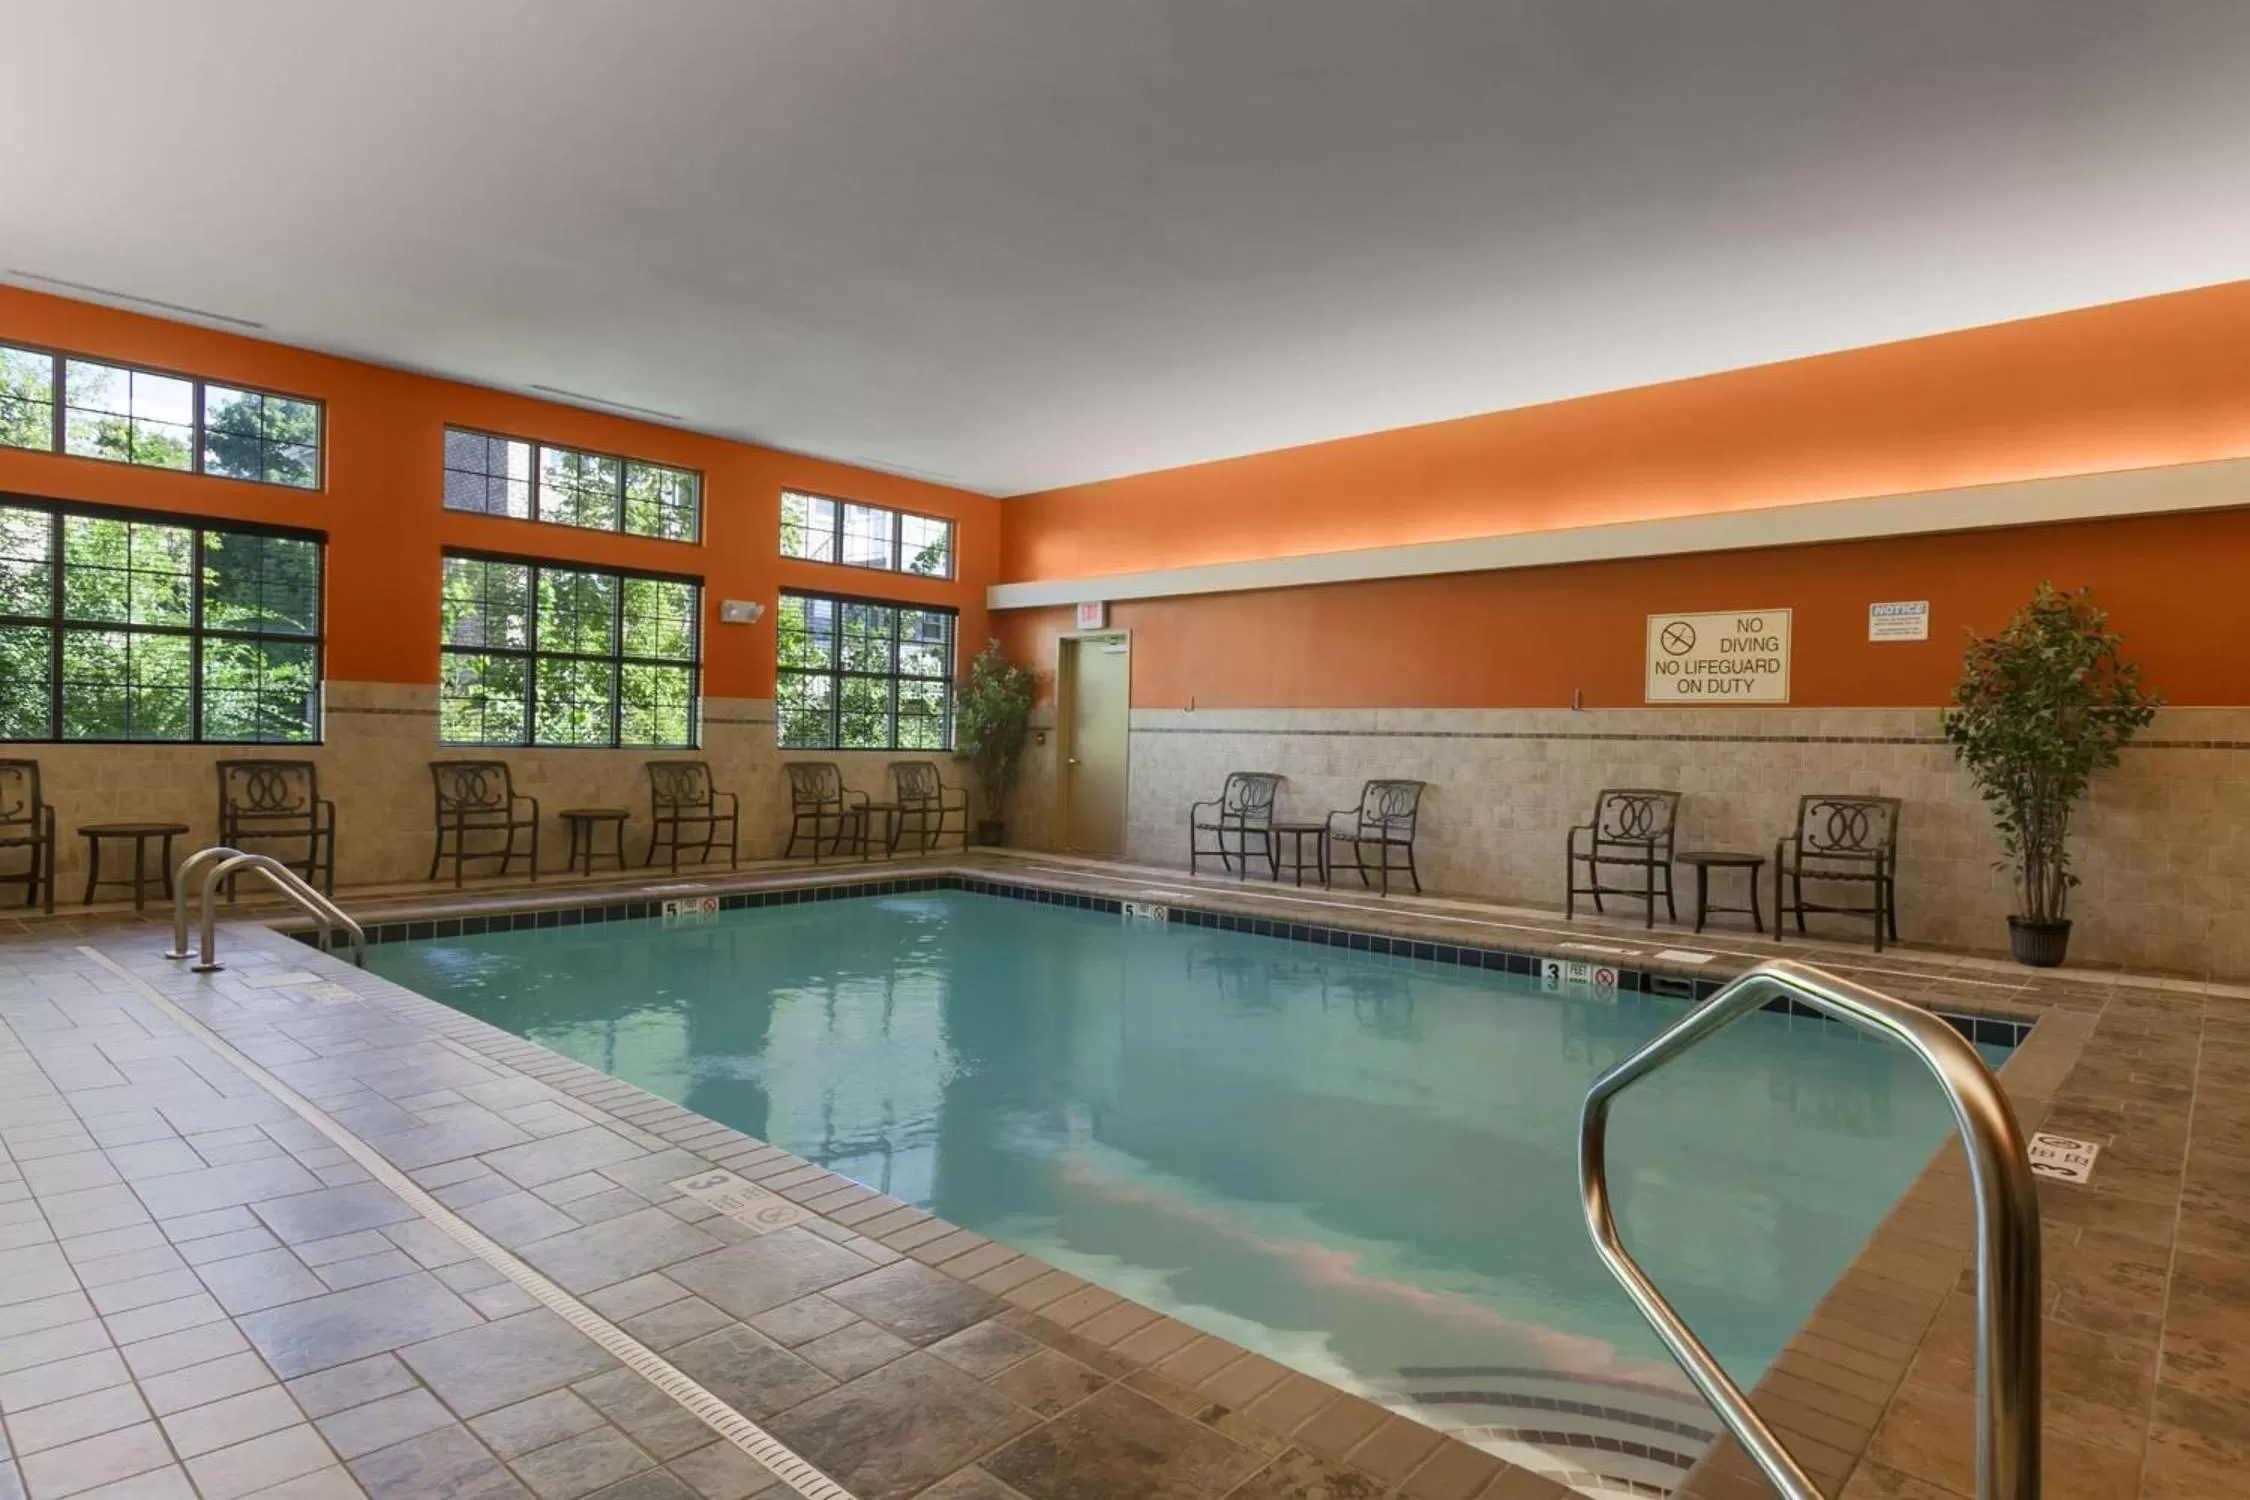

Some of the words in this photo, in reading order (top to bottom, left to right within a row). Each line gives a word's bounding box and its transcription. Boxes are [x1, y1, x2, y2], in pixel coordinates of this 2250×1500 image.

[1874, 604, 1924, 616] NOTICE
[1737, 617, 1763, 633] NO
[1720, 636, 1779, 653] DIVING
[1655, 660, 1680, 675] NO
[1685, 658, 1780, 675] LIFEGUARD
[1677, 679, 1702, 694] ON
[1707, 679, 1755, 694] DUTY
[667, 903, 677, 916] 5
[1126, 904, 1134, 917] 5
[1547, 963, 1560, 981] 3
